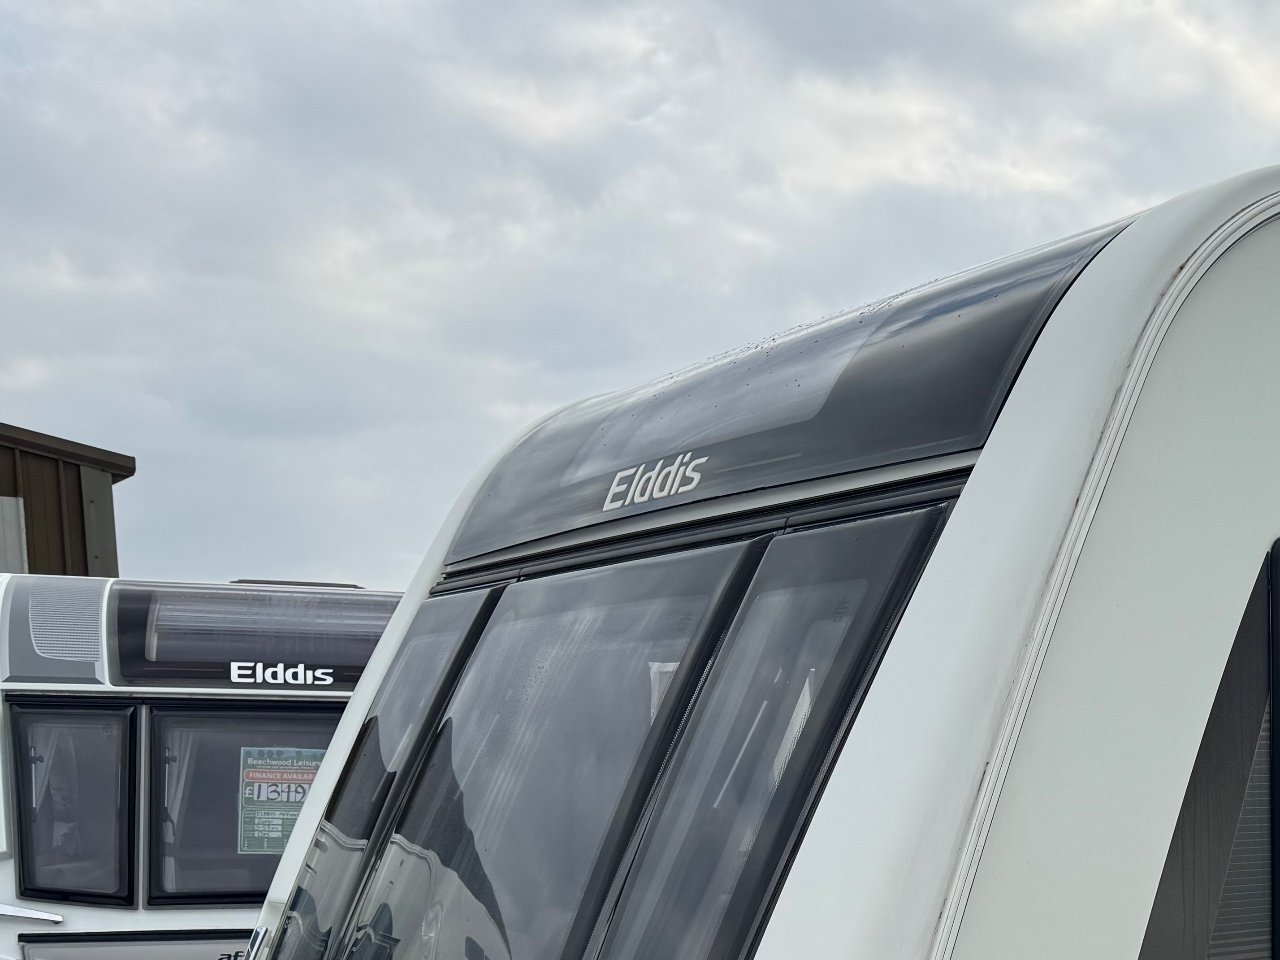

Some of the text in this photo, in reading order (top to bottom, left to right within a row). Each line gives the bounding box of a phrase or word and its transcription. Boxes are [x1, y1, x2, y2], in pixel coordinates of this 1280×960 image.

[602, 451, 710, 512] Elddis
[230, 661, 334, 685] Elddis
[247, 757, 292, 766] Beechwood
[249, 771, 315, 780] FINANCE AVAILAB
